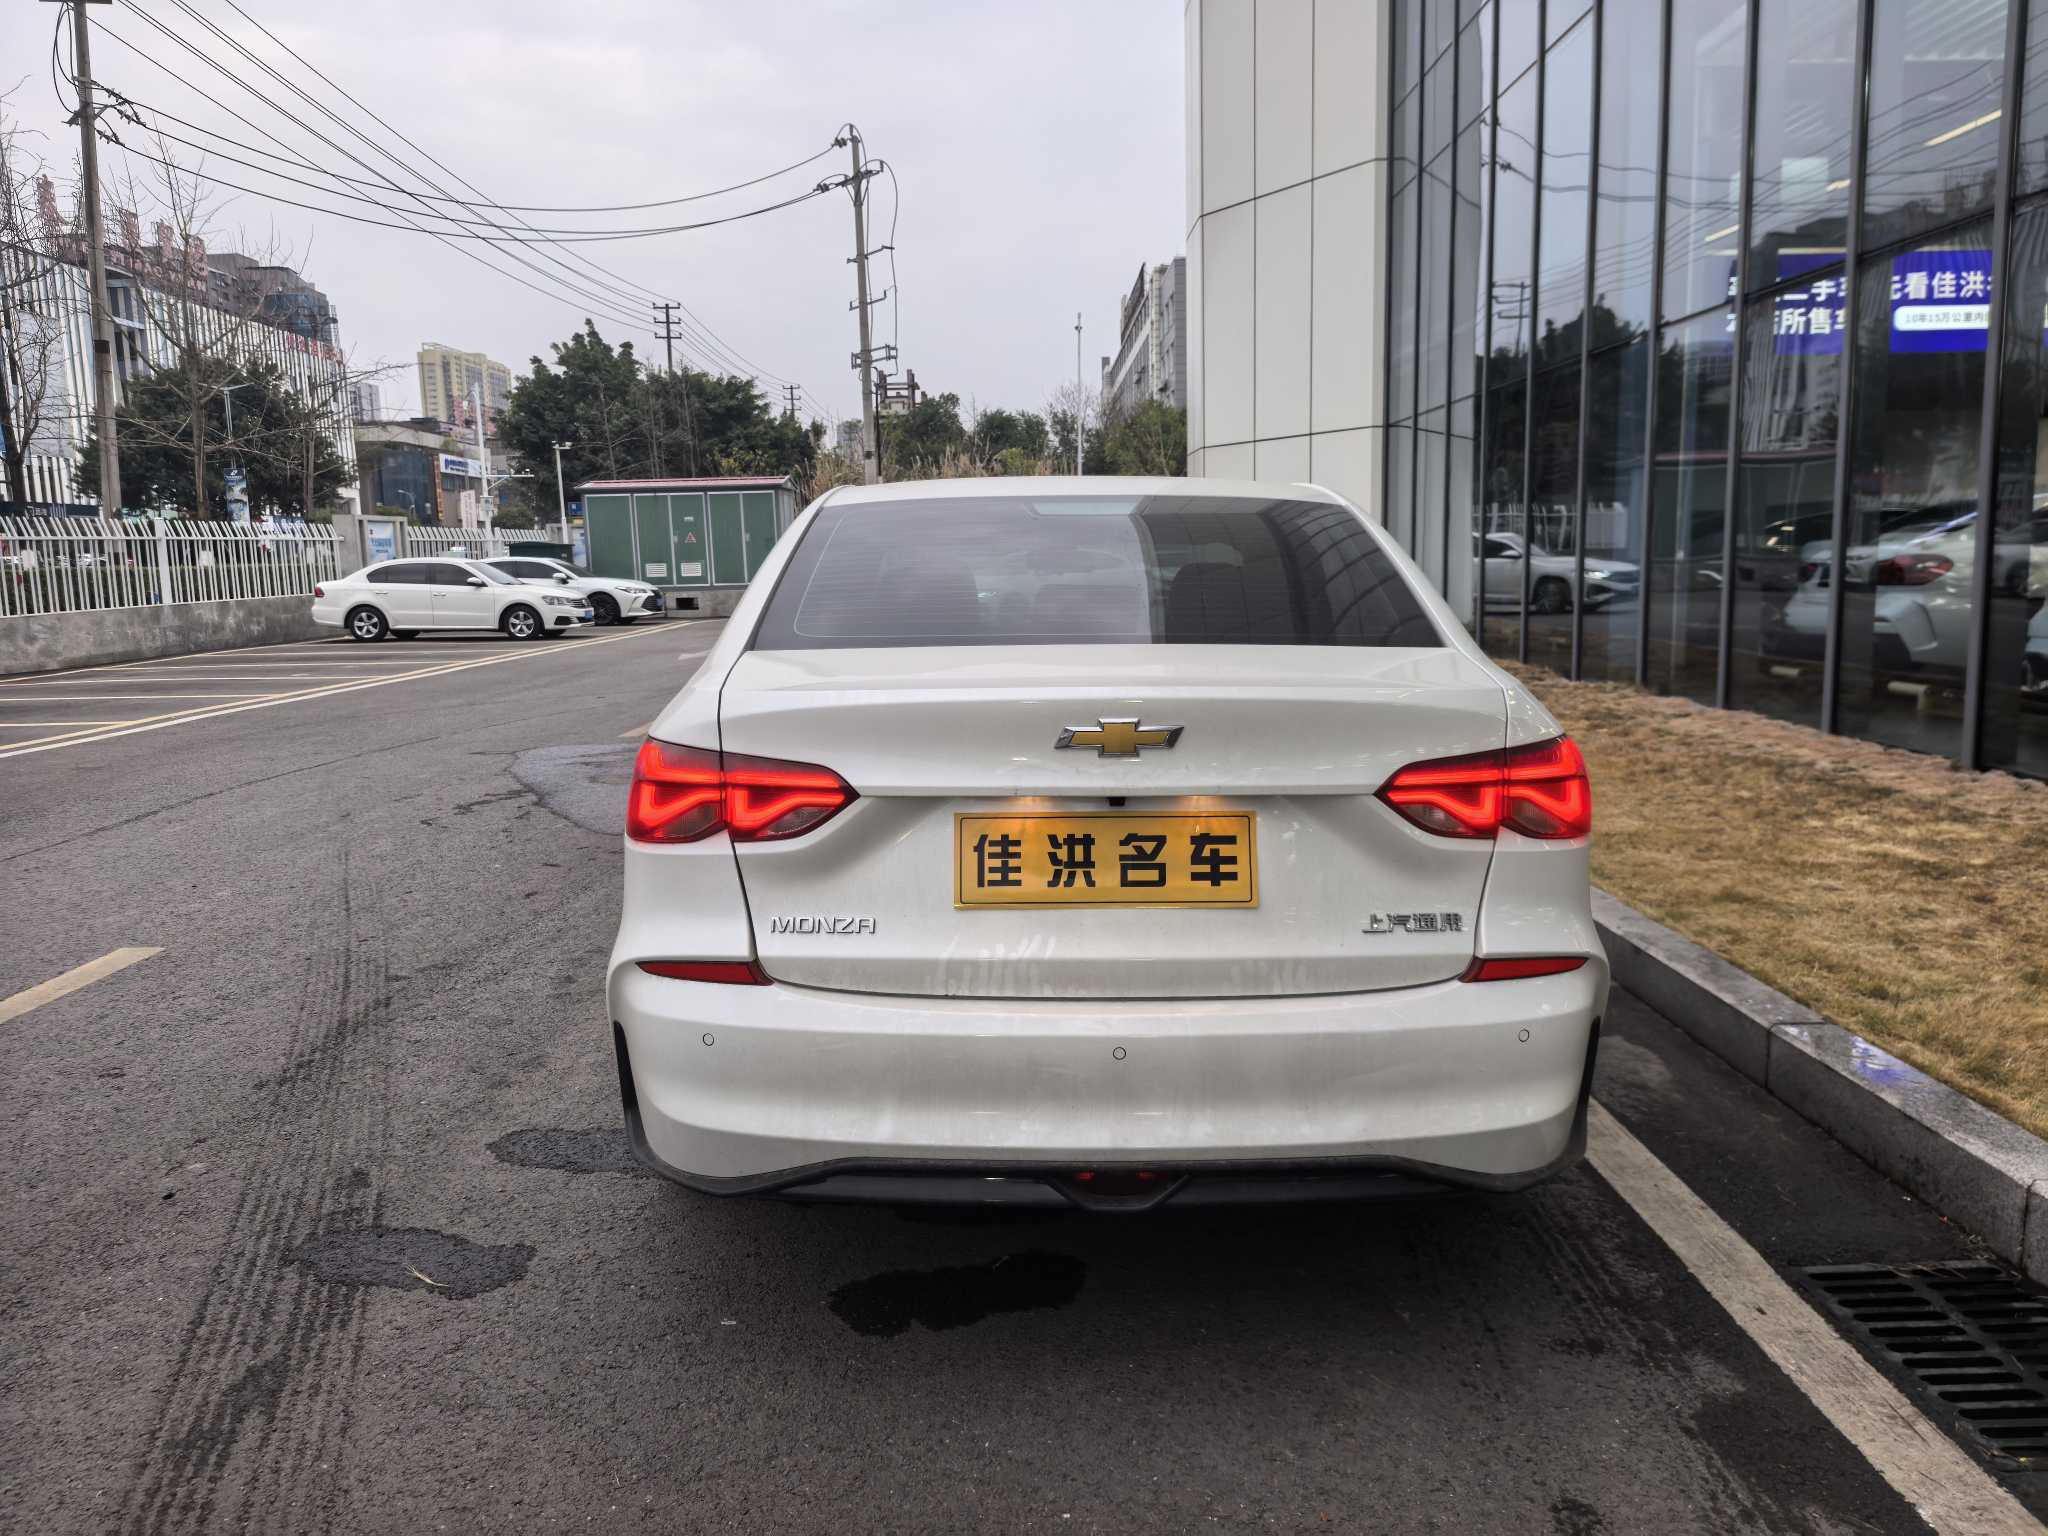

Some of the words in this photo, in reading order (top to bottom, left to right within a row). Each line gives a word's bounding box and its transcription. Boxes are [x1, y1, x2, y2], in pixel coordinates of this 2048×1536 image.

[973, 833, 1239, 888] 佳洪名车
[770, 915, 876, 934] MONZA
[1361, 912, 1463, 934] 上汽通用
